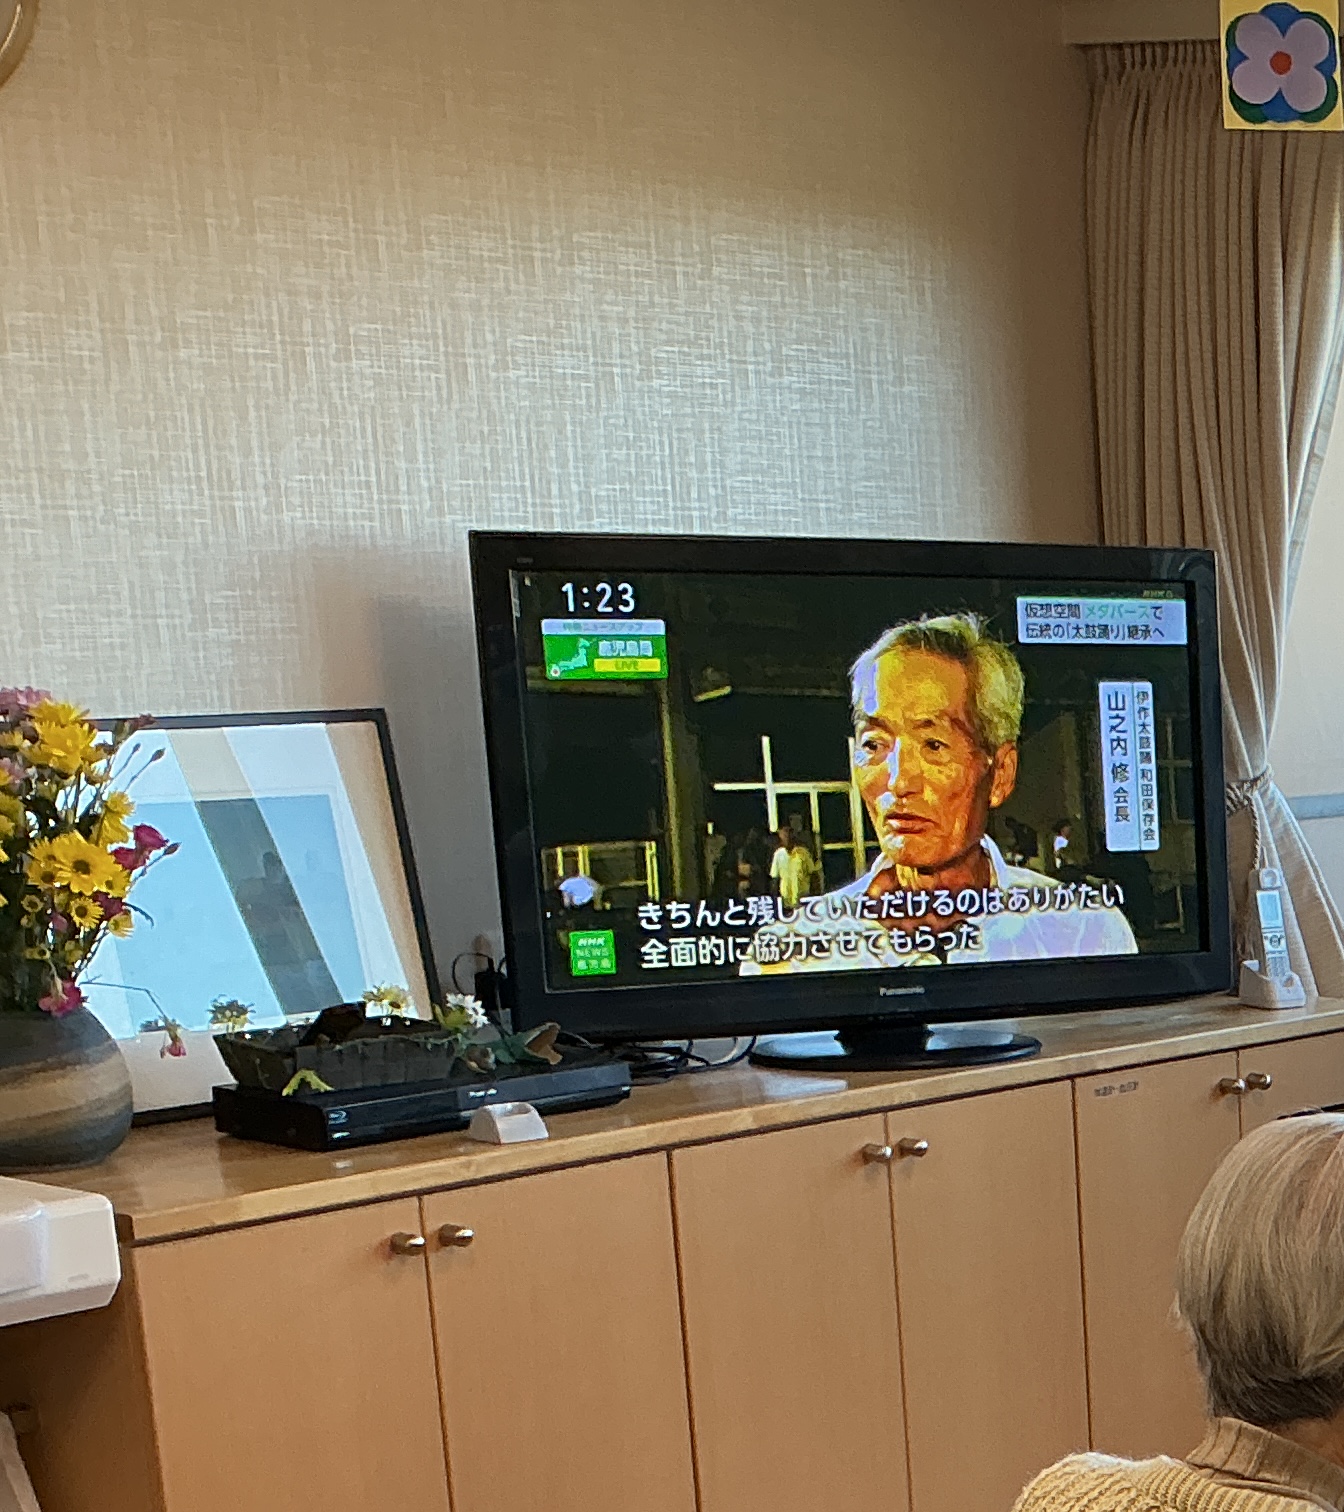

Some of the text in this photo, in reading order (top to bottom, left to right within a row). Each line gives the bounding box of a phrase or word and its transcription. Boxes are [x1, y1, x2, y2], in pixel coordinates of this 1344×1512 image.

[561, 582, 635, 612] 1:23
[638, 884, 1124, 930] きちんと残していただけるのはありがたい
[640, 923, 982, 969] 全面的に協力させてもらった
